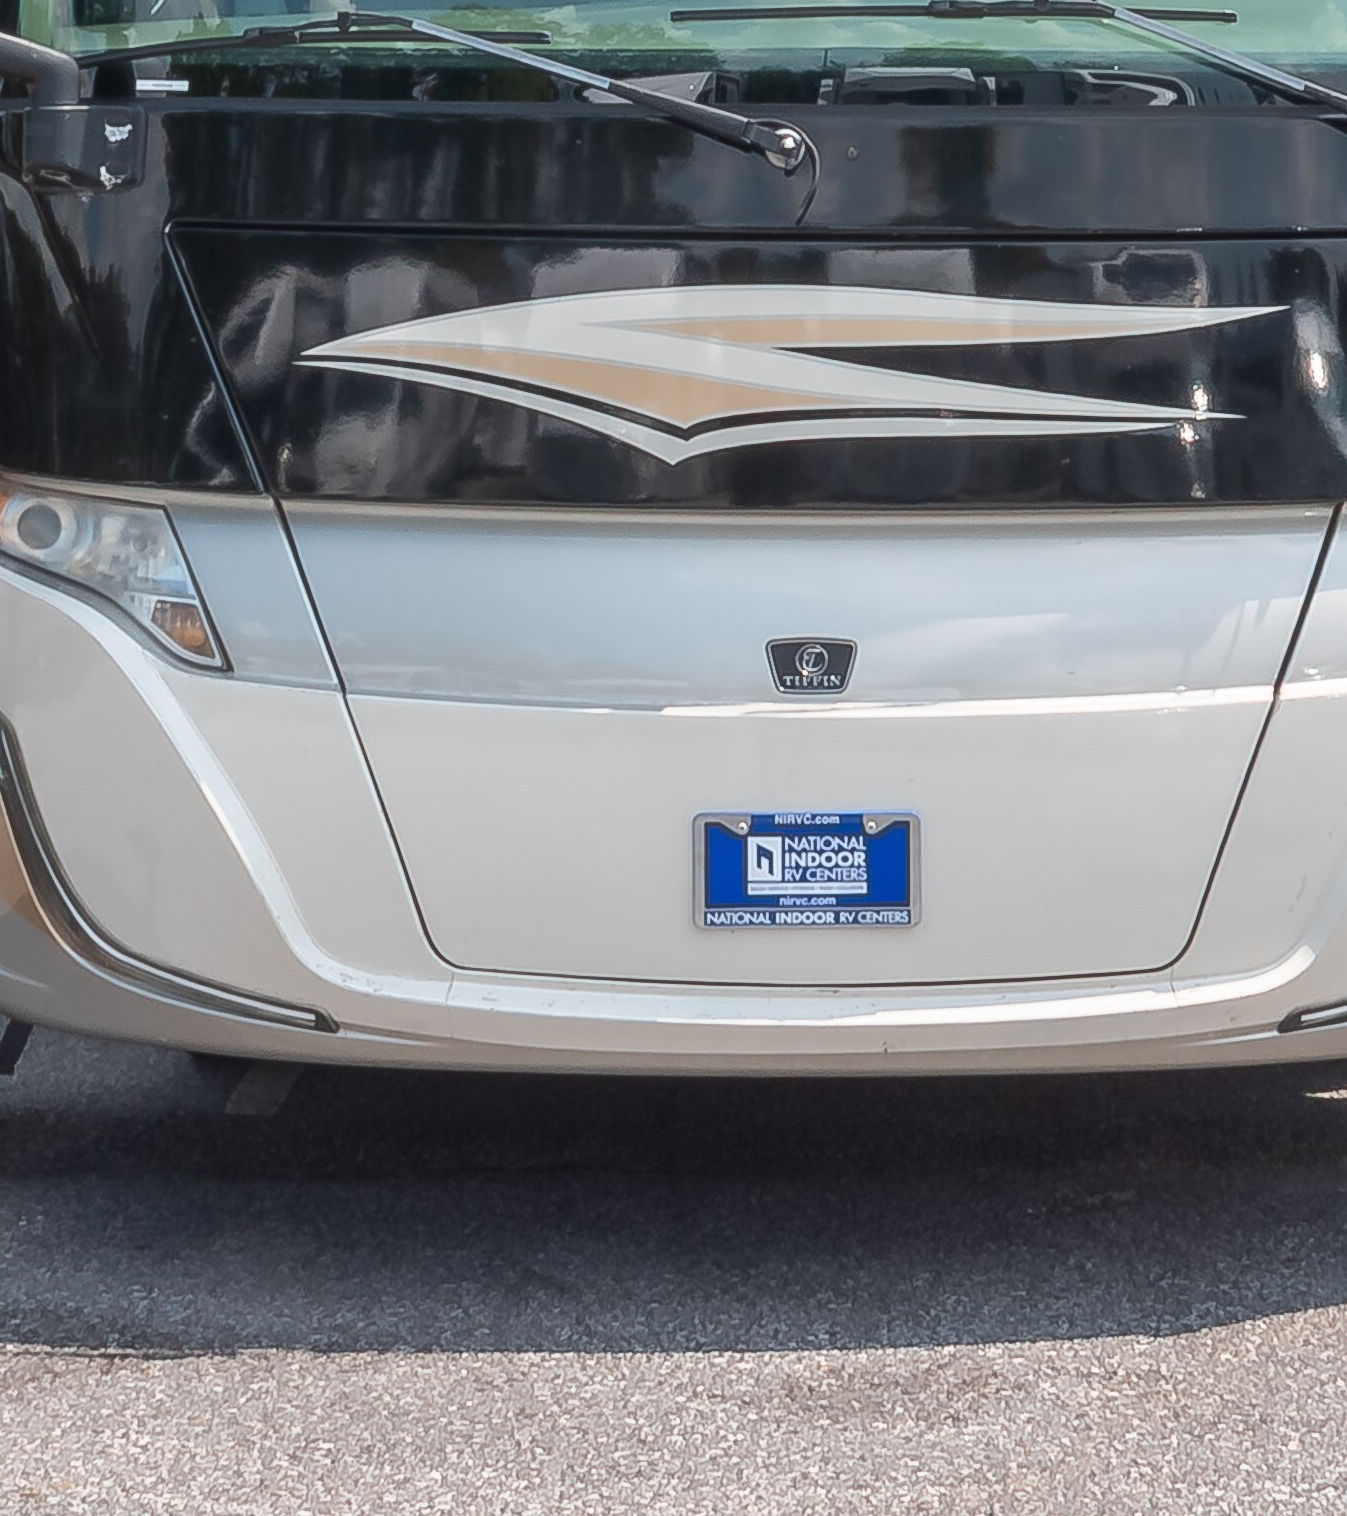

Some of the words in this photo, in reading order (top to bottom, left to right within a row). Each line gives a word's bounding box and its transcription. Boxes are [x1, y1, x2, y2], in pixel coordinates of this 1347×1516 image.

[783, 675, 842, 687] TIFFIN
[774, 813, 840, 825] NIRVC.com
[784, 835, 867, 851] NATIONAL
[784, 851, 867, 867] INDOOR
[784, 868, 803, 882] RV
[805, 867, 868, 881] CENTERS
[779, 895, 837, 906] nirvc.com
[706, 911, 772, 925] NATIONAL
[775, 911, 835, 924] INDOOR
[839, 911, 856, 924] RV
[857, 910, 909, 924] CENTERS
